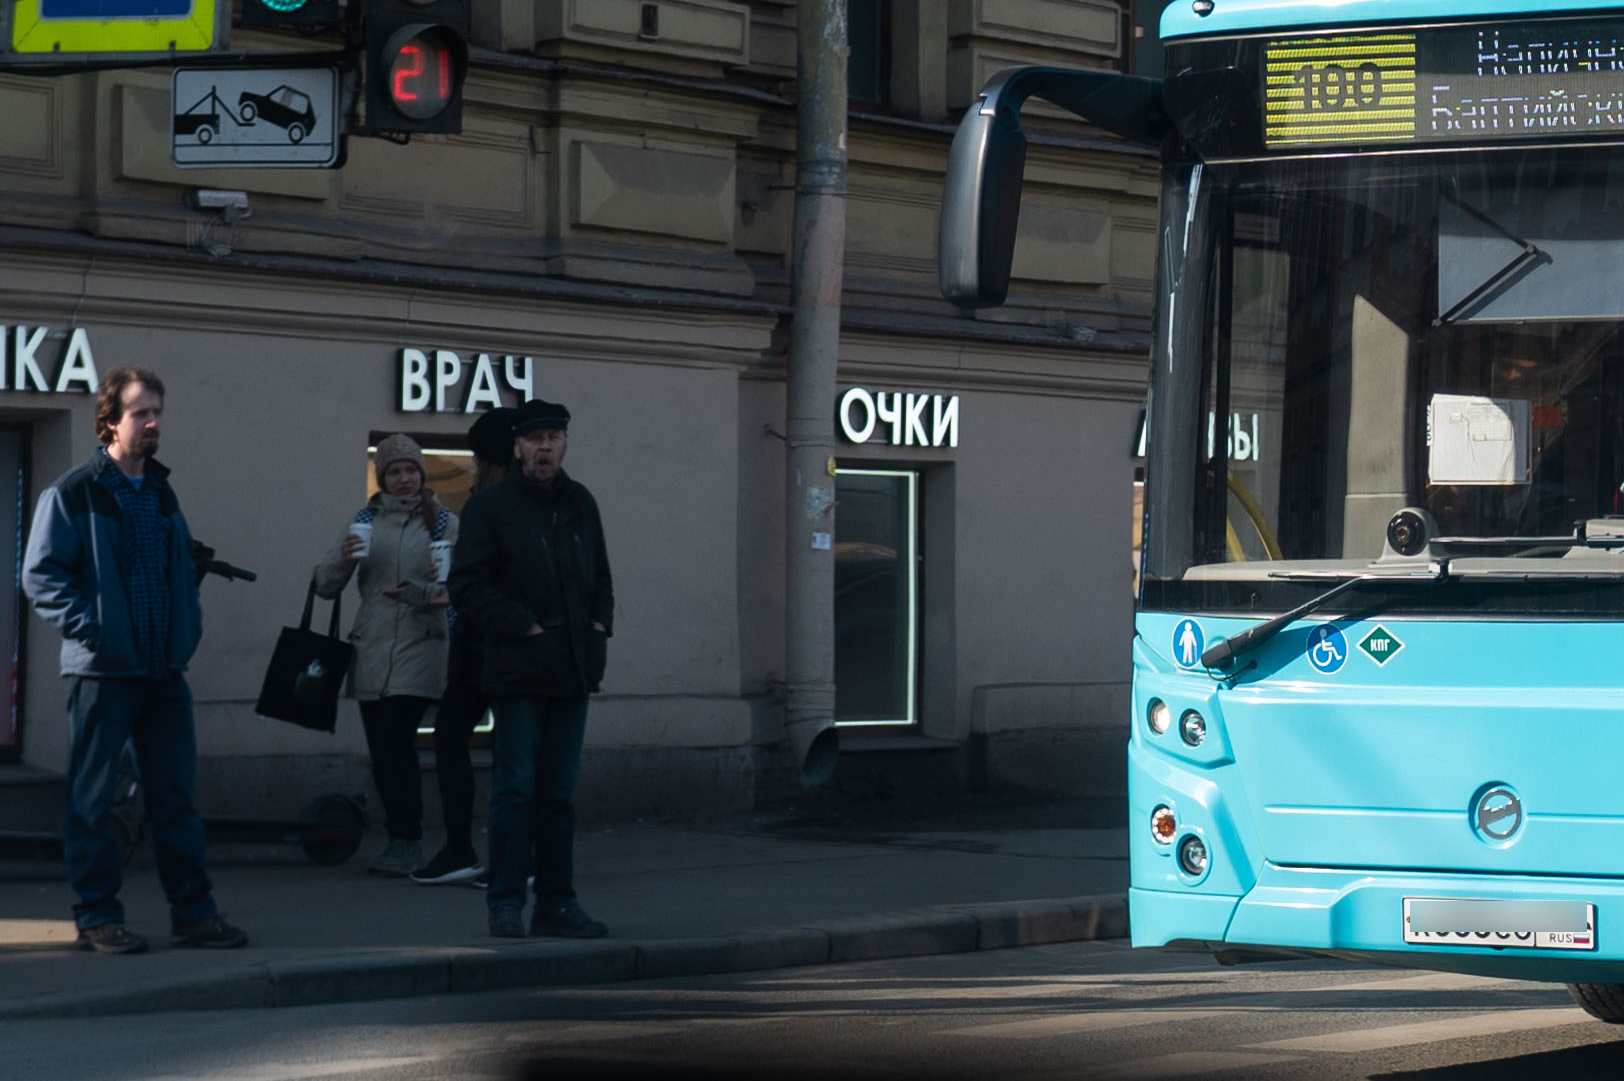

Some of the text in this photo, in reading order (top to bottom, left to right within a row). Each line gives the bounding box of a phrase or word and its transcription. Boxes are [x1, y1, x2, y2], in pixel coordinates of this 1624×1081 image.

[395, 45, 450, 100] 21
[1294, 61, 1382, 113] 100
[402, 348, 534, 413] ВРАЧ
[840, 387, 959, 447] ОЧКИ
[1370, 638, 1390, 652] КПГ
[1549, 933, 1572, 944] RUS
